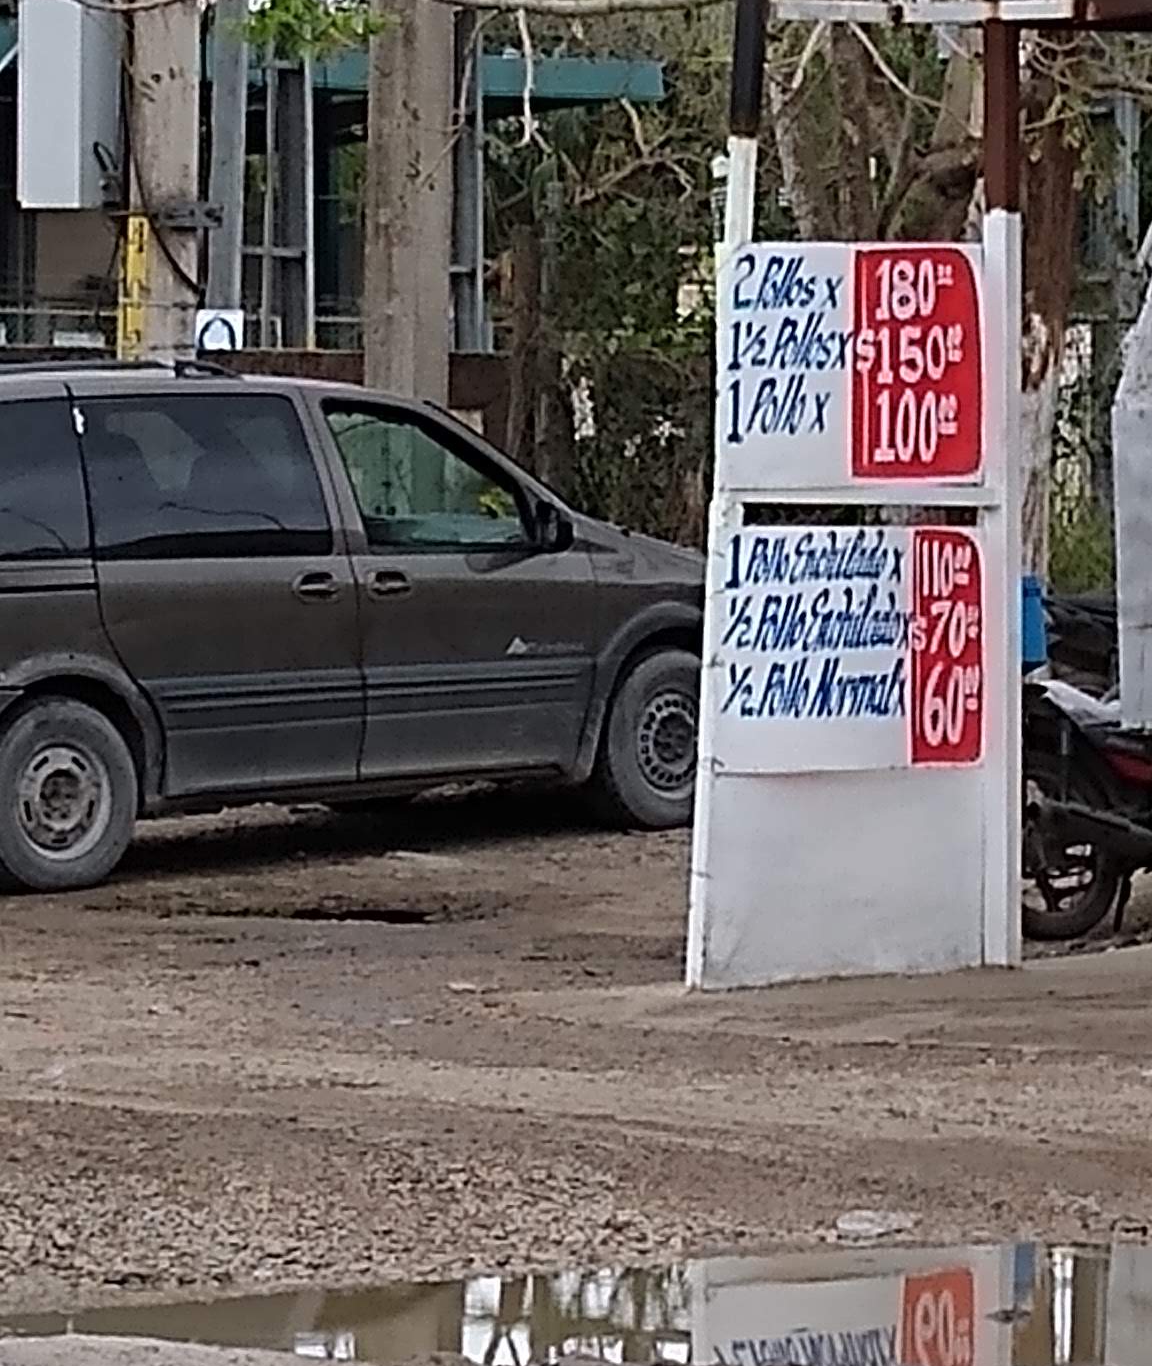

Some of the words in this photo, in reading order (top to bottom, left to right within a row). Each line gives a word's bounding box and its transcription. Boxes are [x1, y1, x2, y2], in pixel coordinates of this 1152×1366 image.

[733, 254, 755, 310] 2
[754, 256, 816, 311] Pollos
[728, 380, 743, 443] 1
[746, 374, 806, 435] Pollo
[725, 534, 741, 588] 1
[745, 537, 790, 584] Pollo
[753, 593, 807, 652] Pollo
[758, 658, 810, 718] Pollo
